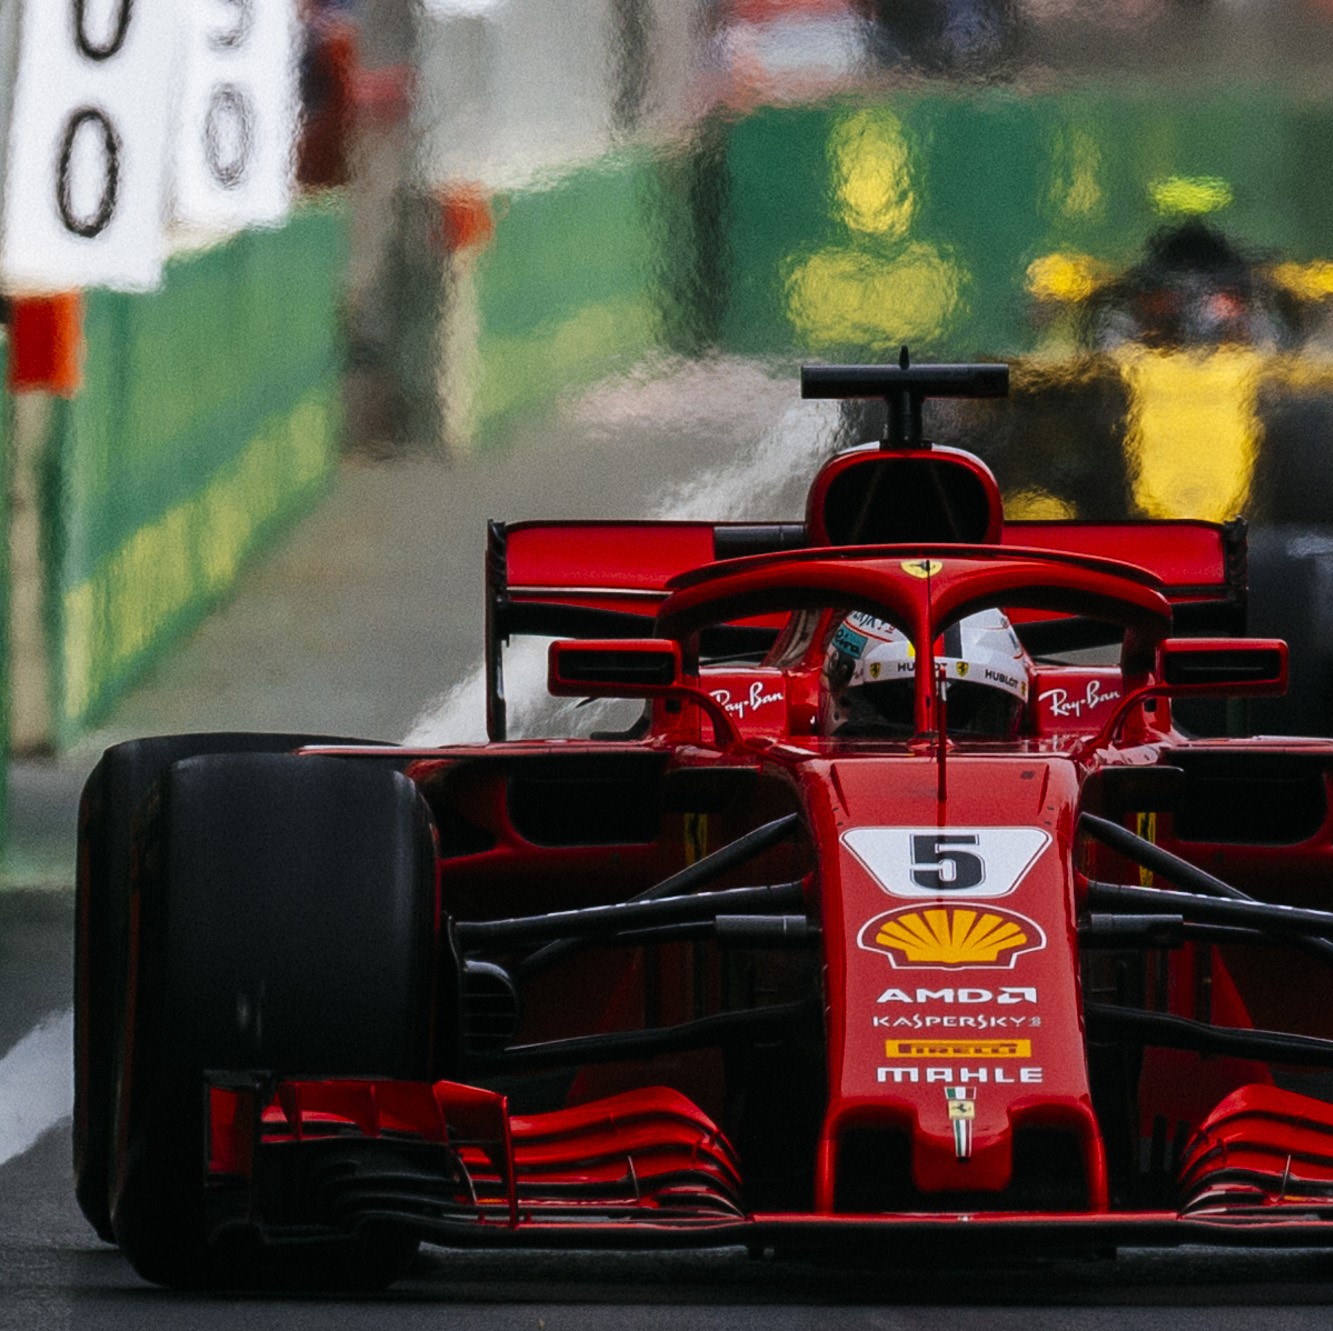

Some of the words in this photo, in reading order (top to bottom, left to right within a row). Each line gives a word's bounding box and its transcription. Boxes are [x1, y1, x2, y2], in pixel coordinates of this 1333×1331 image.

[984, 668, 1019, 689] HUBLOT
[1038, 680, 1120, 717] Ray-Ban
[909, 834, 986, 891] 5
[876, 987, 994, 1004] AMD
[872, 1013, 1026, 1030] KASPERSKY
[876, 1066, 1043, 1084] MAHLE
